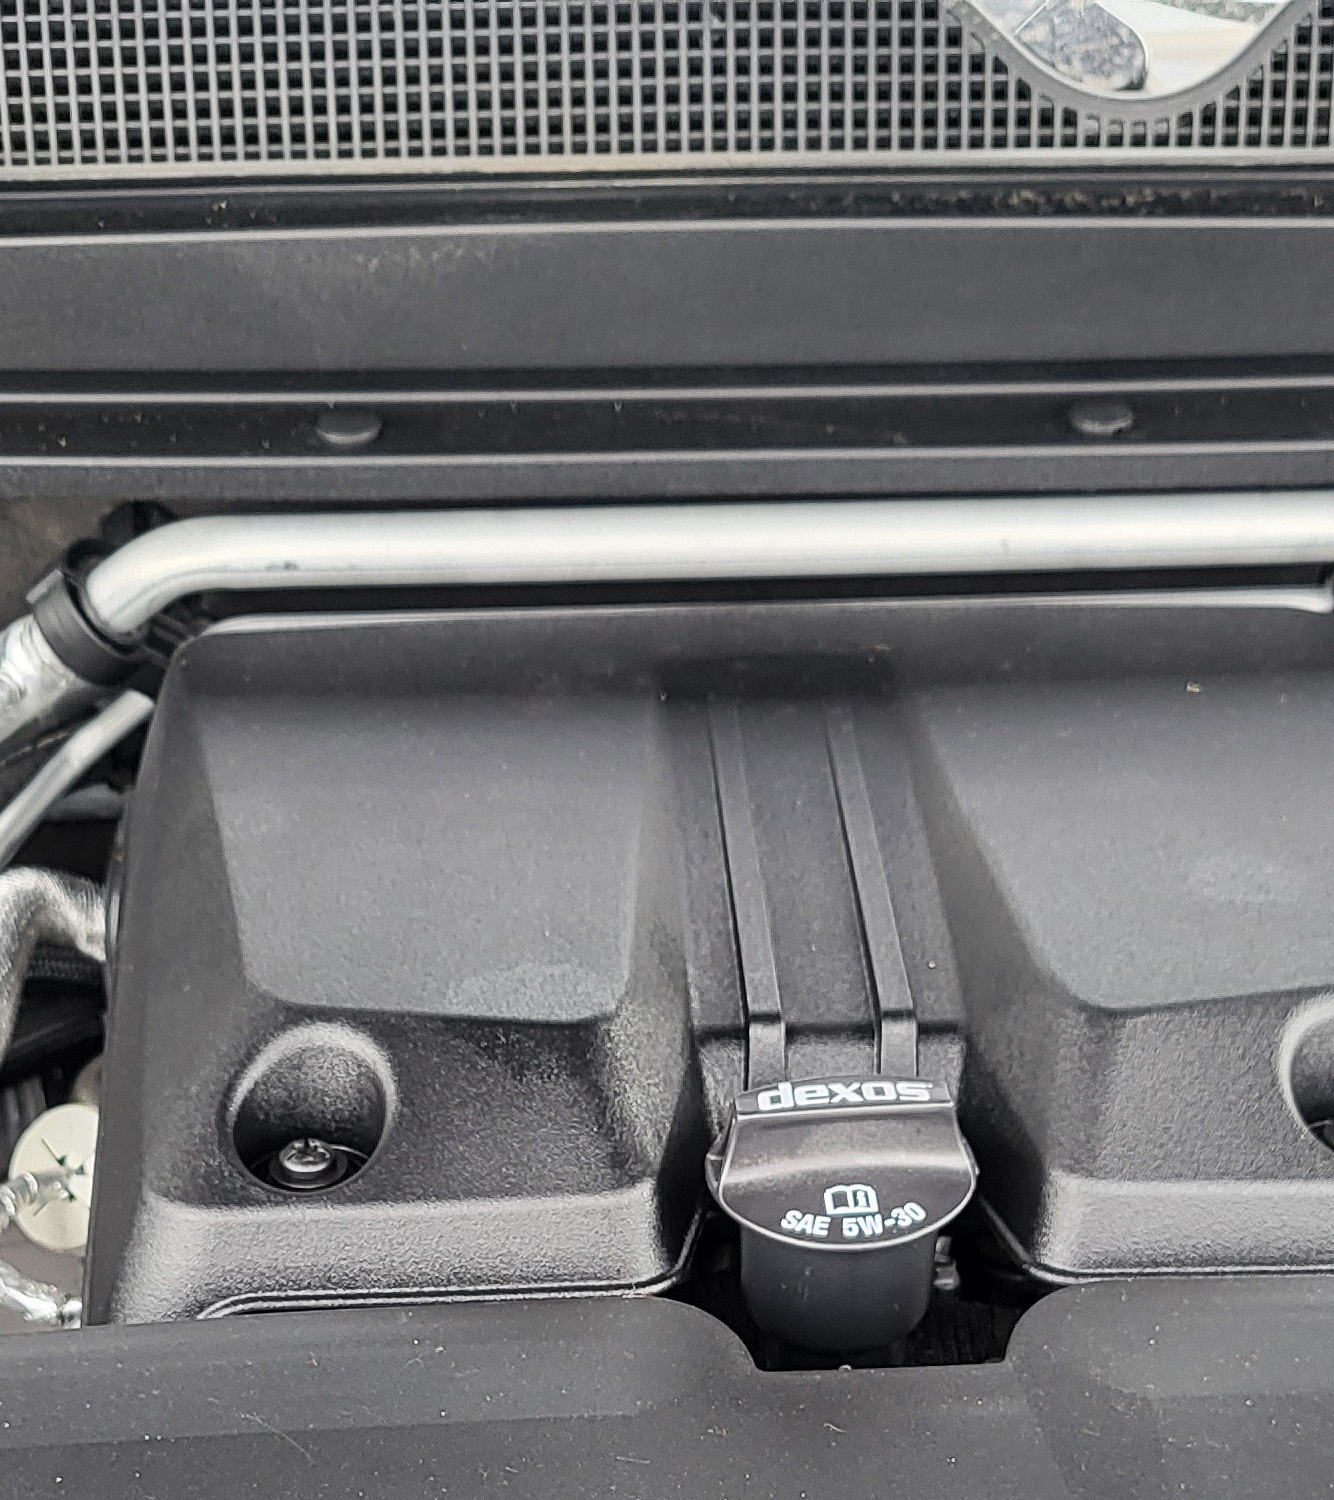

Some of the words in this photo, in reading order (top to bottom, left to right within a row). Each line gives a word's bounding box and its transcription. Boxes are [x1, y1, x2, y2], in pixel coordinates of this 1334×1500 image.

[757, 1081, 933, 1111] dexos
[781, 1209, 831, 1237] SAE
[841, 1202, 926, 1237] 5W-30
